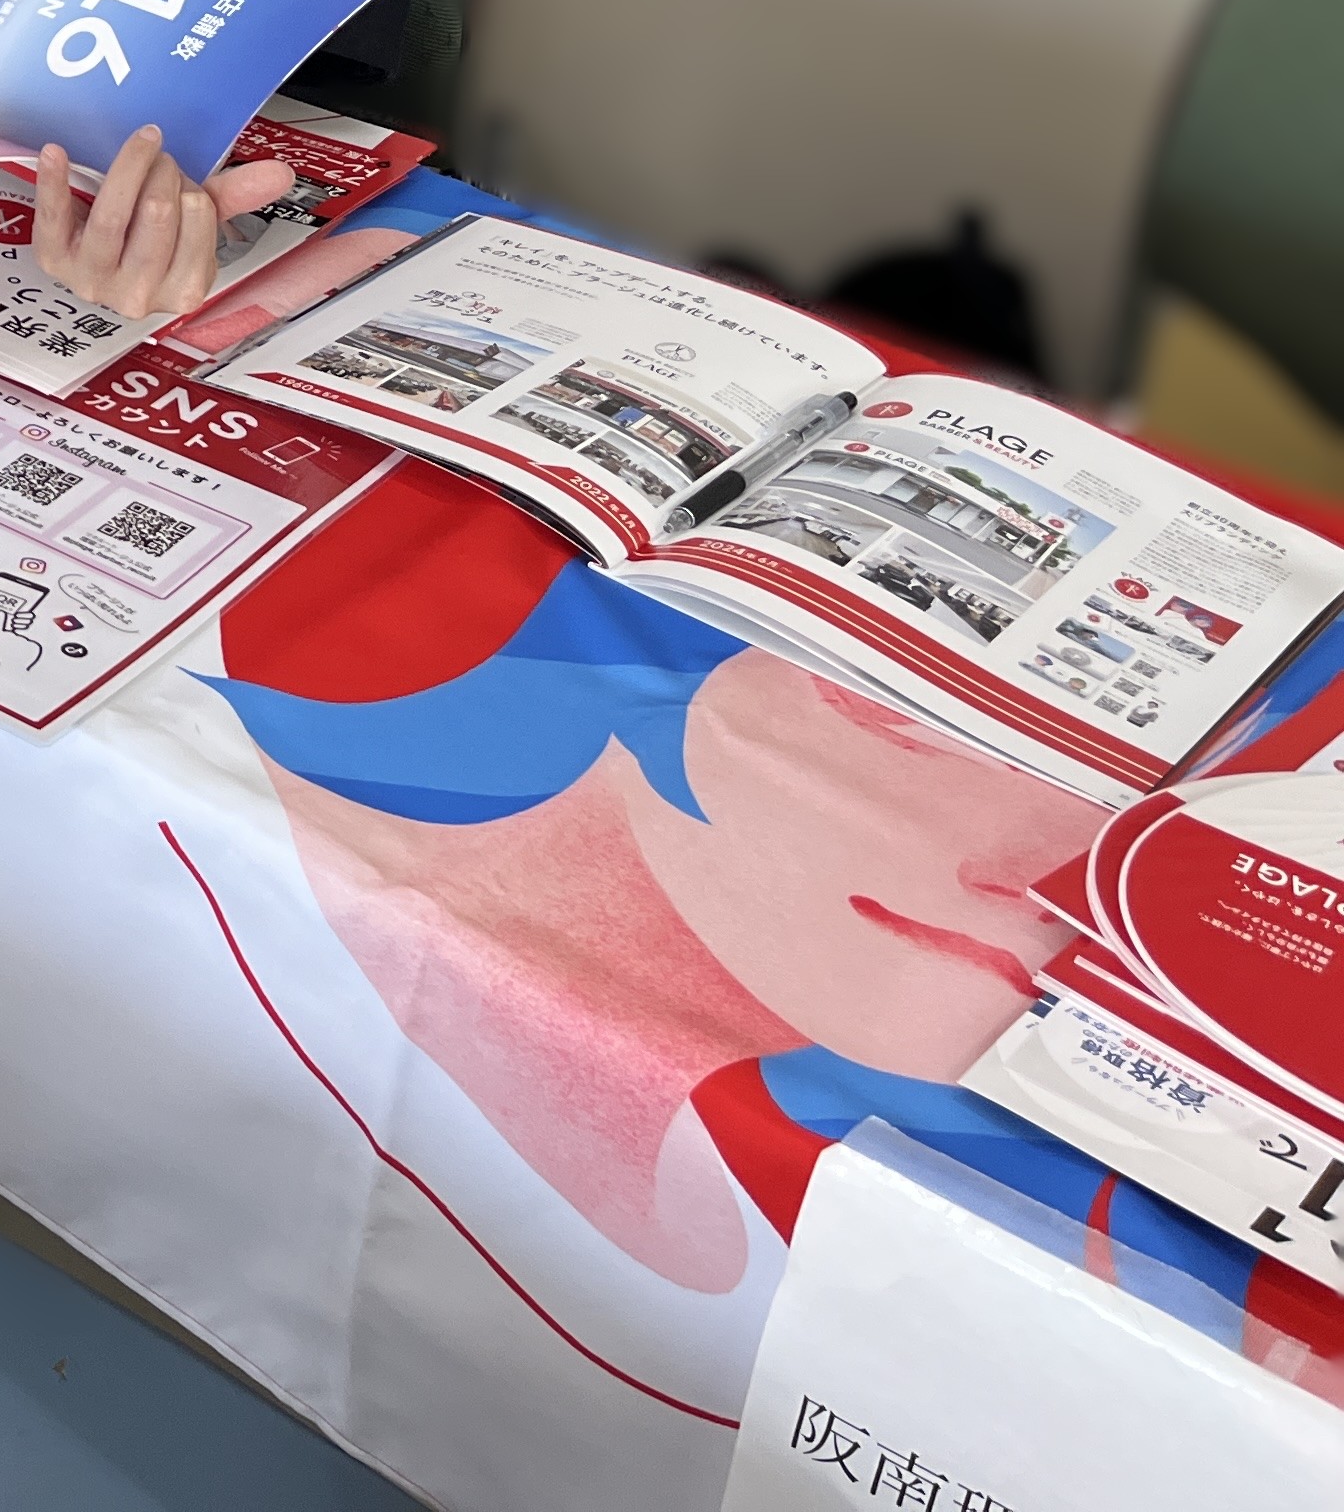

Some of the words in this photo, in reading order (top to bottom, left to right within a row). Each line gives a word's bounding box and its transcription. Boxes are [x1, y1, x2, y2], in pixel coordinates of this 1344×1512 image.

[6, 276, 122, 339] 働こう。
[621, 354, 683, 382] PLAGE
[72, 384, 209, 448] カウント
[111, 370, 259, 439] SNS
[48, 437, 127, 476] Instagram
[873, 449, 928, 473] PLAGE
[918, 420, 972, 441] BARBER
[984, 441, 1042, 471] BEAUTY
[927, 408, 1054, 466] PLAGE
[1080, 1038, 1214, 1113] 資格取得
